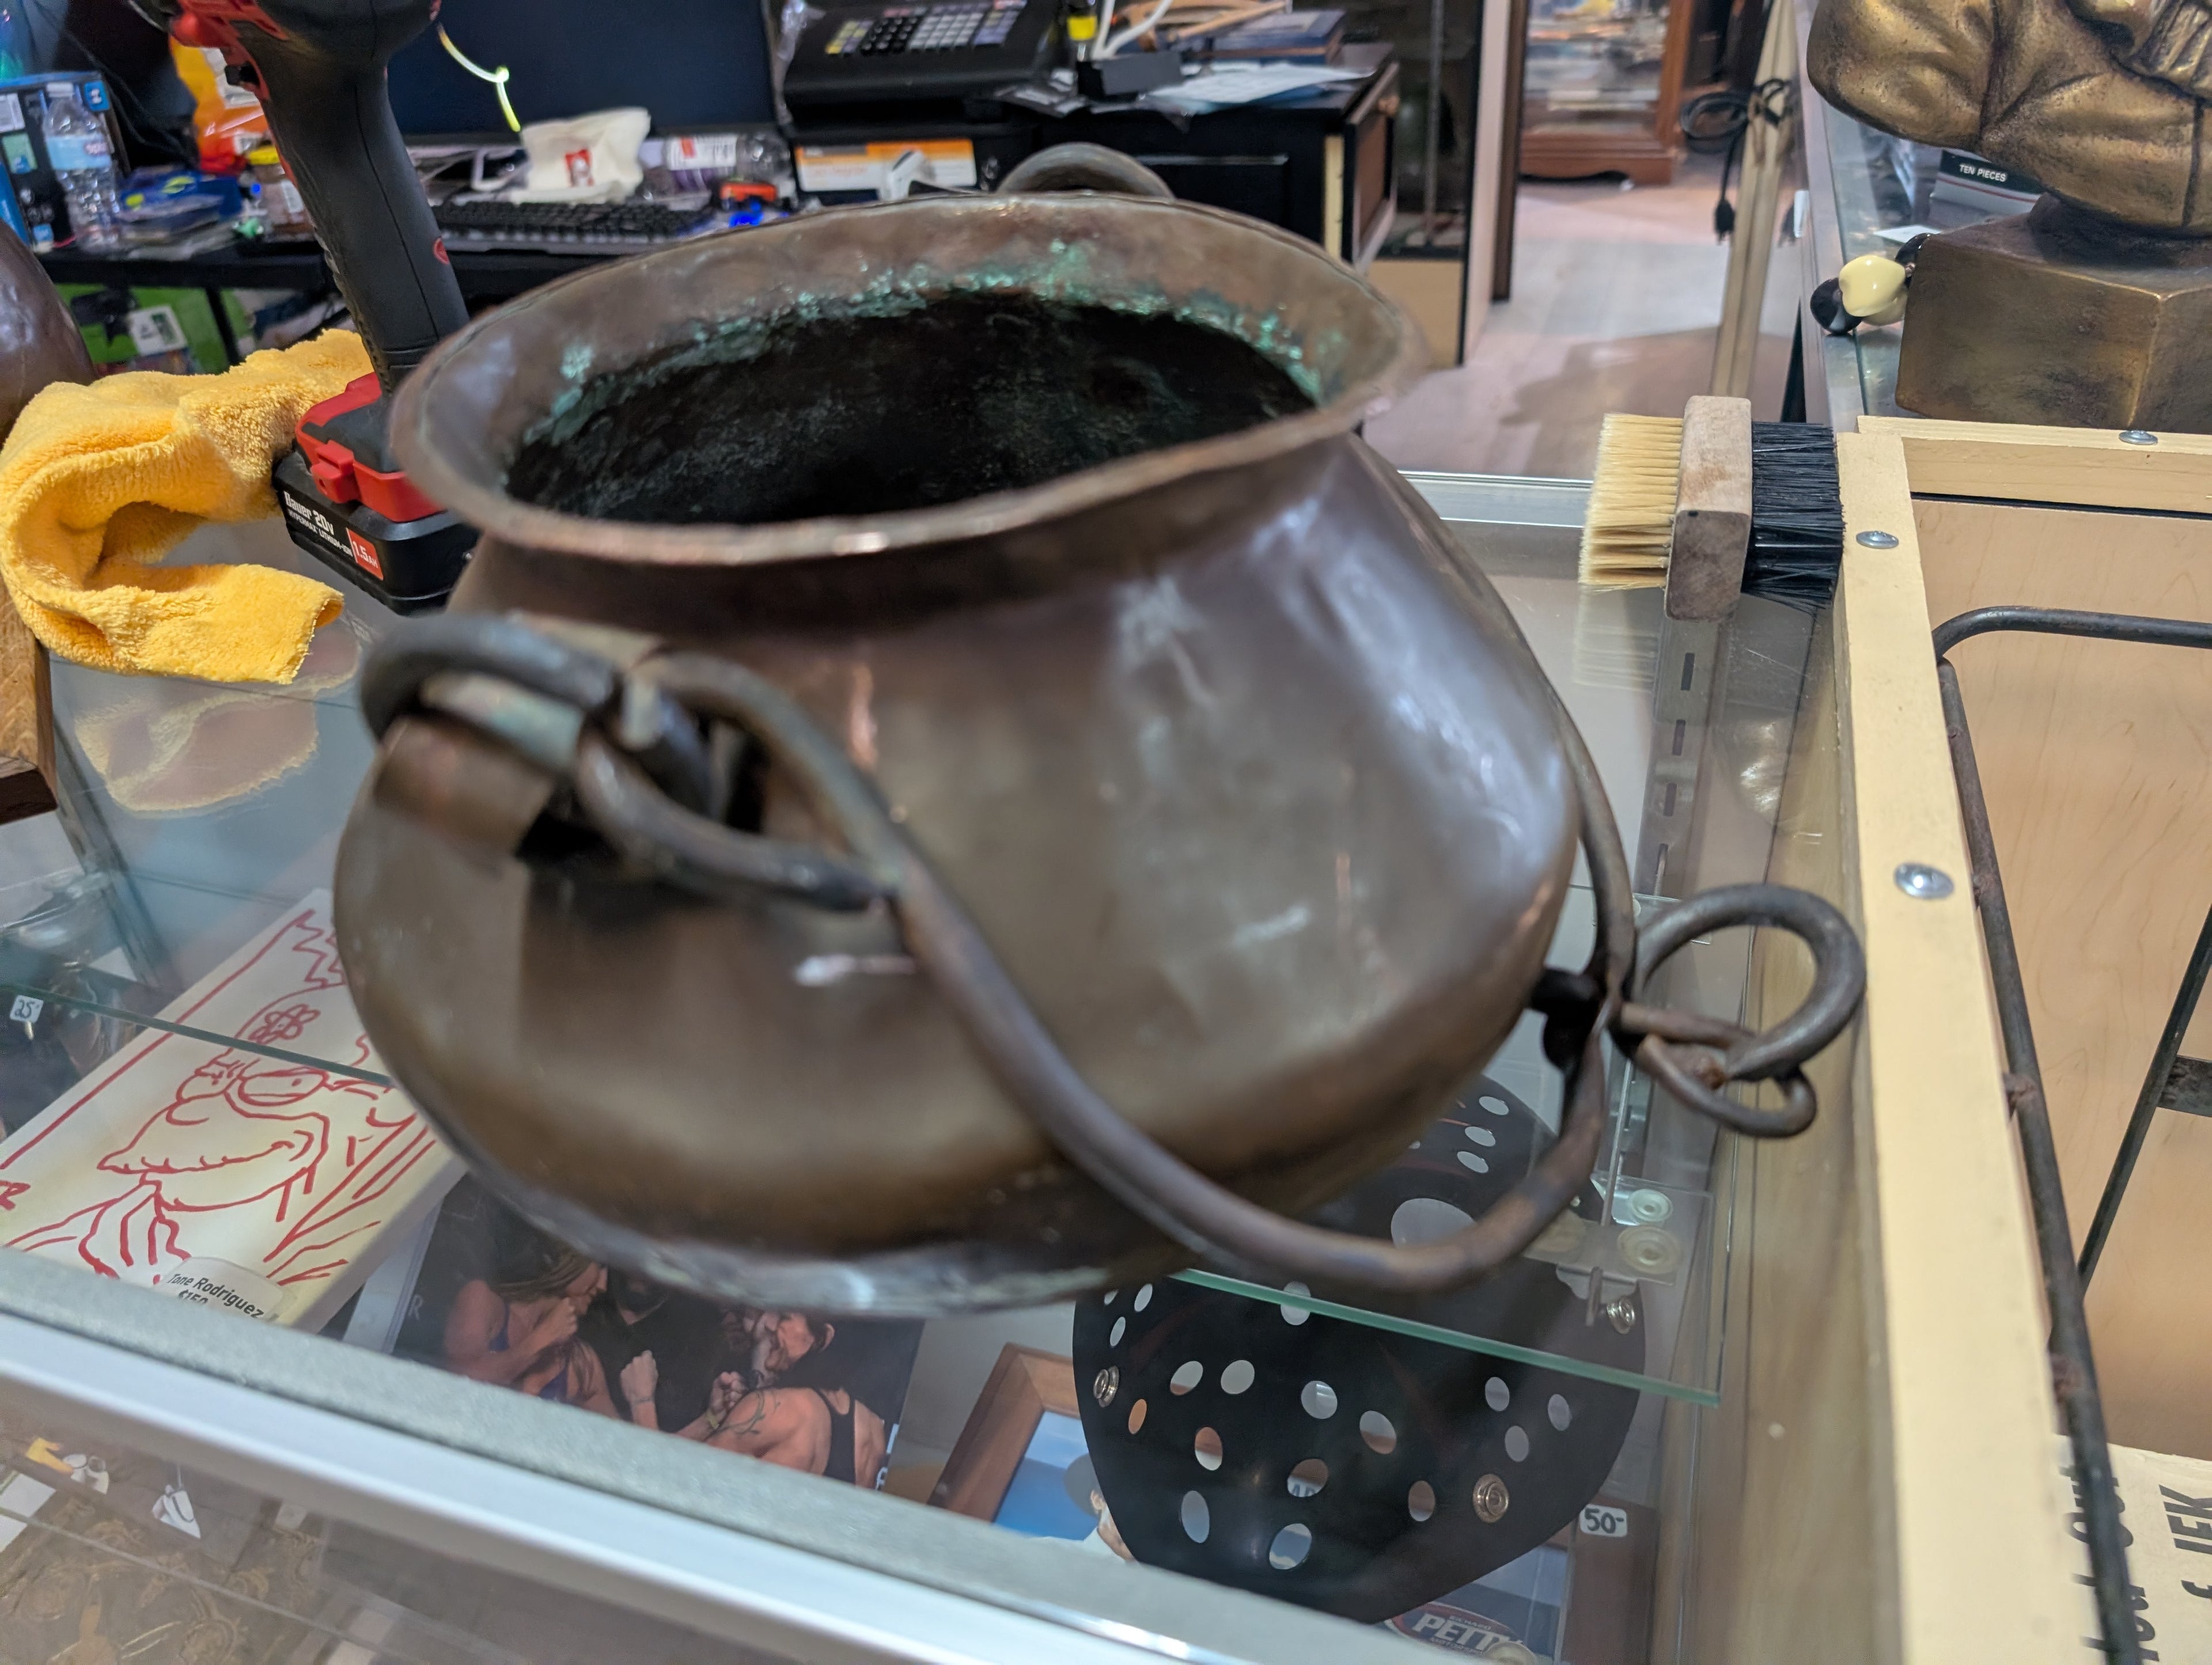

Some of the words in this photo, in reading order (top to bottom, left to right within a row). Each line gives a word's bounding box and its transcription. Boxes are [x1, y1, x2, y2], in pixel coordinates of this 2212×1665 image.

[1959, 164, 1976, 175] TEN
[1977, 168, 2008, 183] PIECES
[284, 490, 312, 520] Bauer
[166, 1273, 195, 1286] Tone
[193, 1277, 265, 1319] Rodriguez
